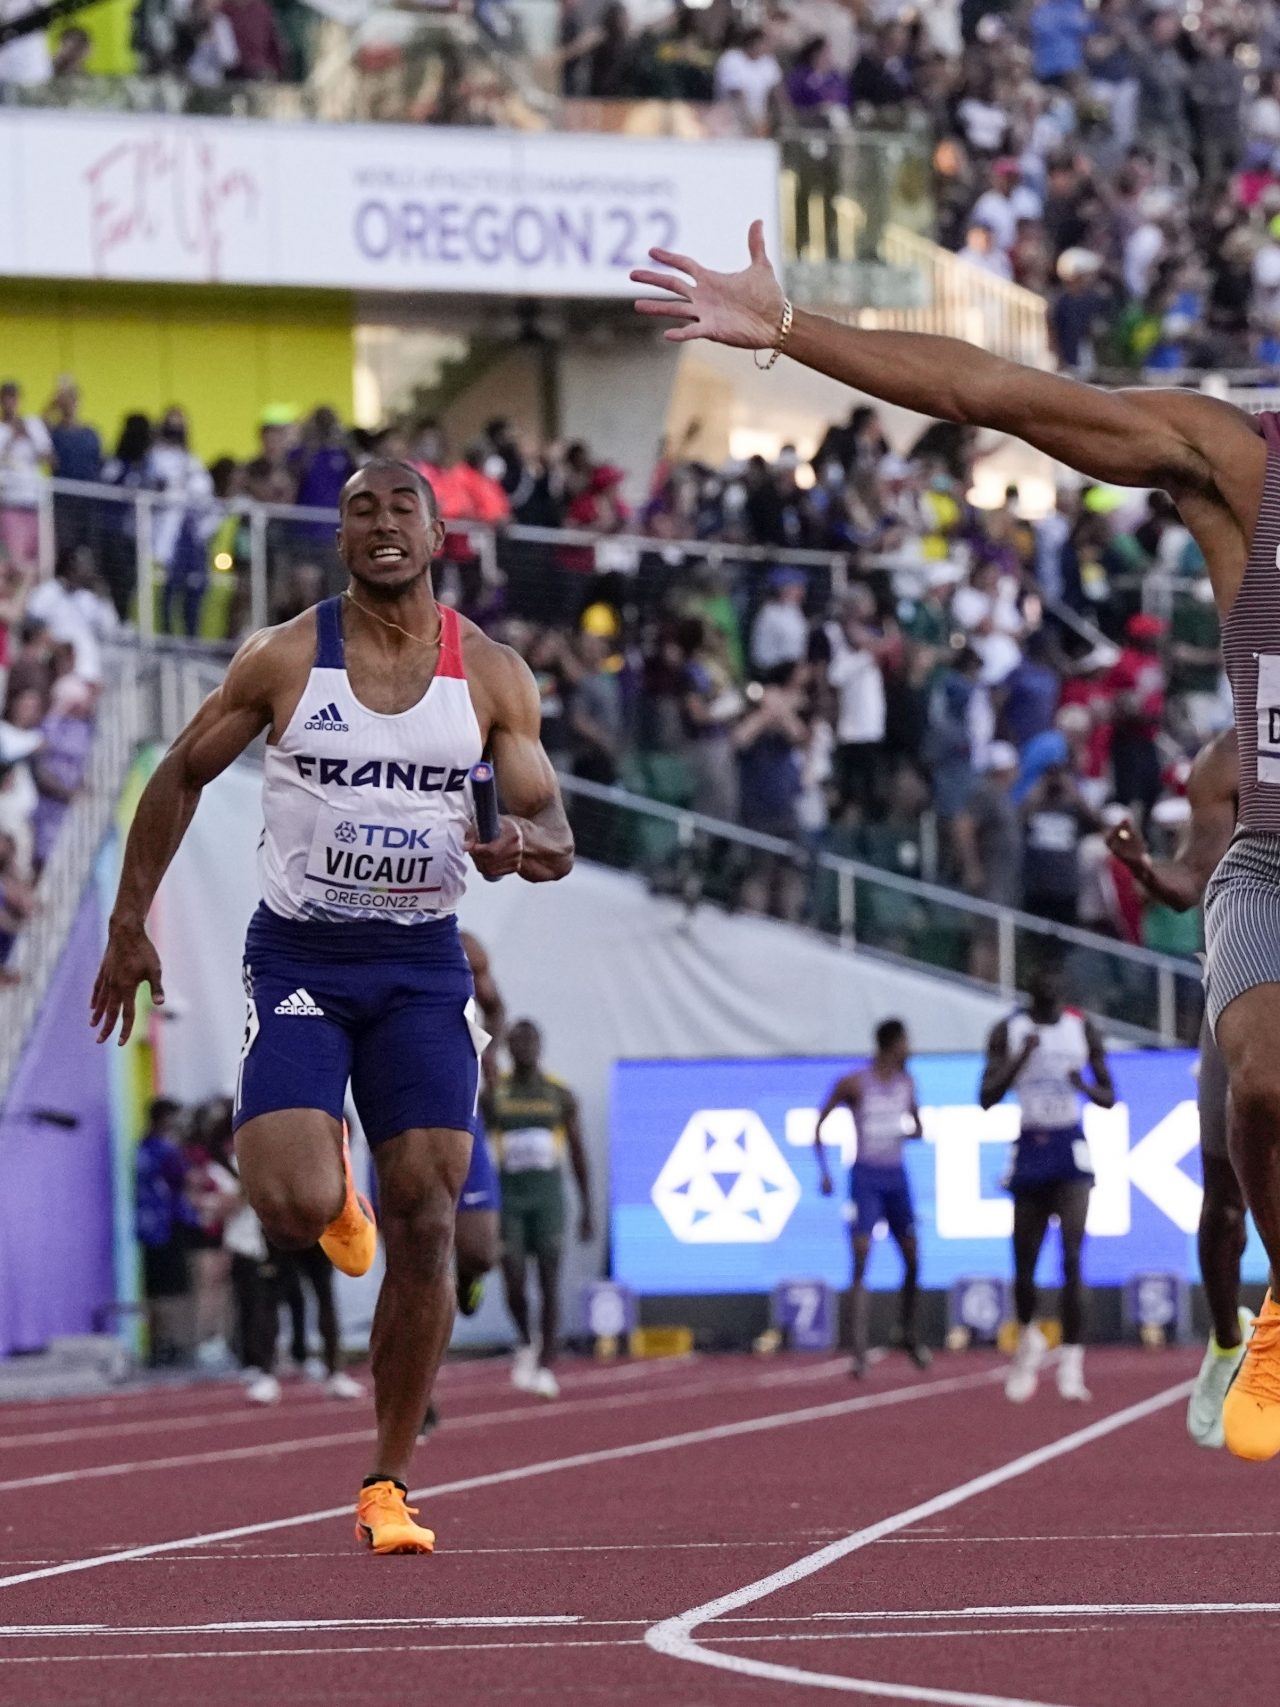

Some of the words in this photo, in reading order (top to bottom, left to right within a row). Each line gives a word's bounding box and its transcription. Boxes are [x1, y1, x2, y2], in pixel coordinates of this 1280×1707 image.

[304, 719, 350, 733] adidas
[295, 755, 470, 793] FRANCE
[359, 824, 432, 850] TDK
[325, 847, 433, 884] VICAUT
[325, 888, 419, 909] OREGON22
[274, 1005, 325, 1016] adidas
